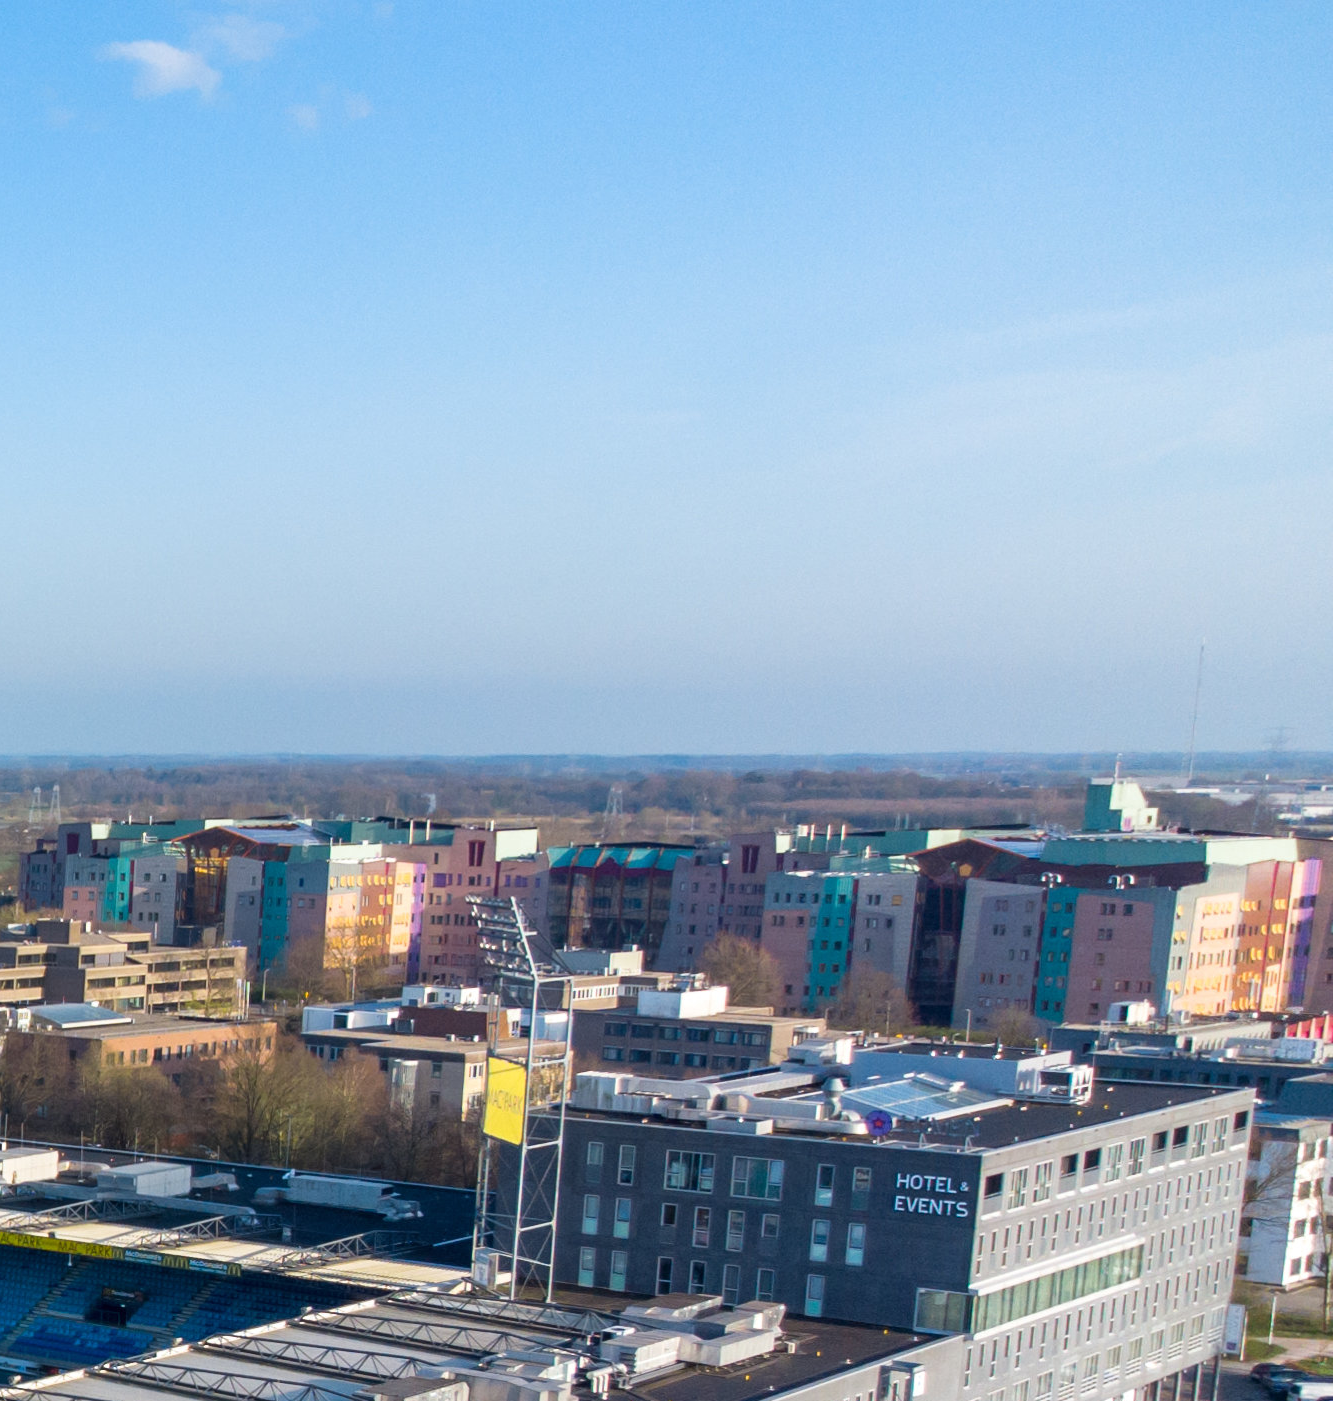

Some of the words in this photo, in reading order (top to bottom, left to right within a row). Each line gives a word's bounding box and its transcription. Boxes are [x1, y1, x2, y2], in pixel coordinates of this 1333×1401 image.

[895, 1172, 958, 1195] HOTEL
[959, 1181, 970, 1192] &
[893, 1195, 970, 1218] EVENTS
